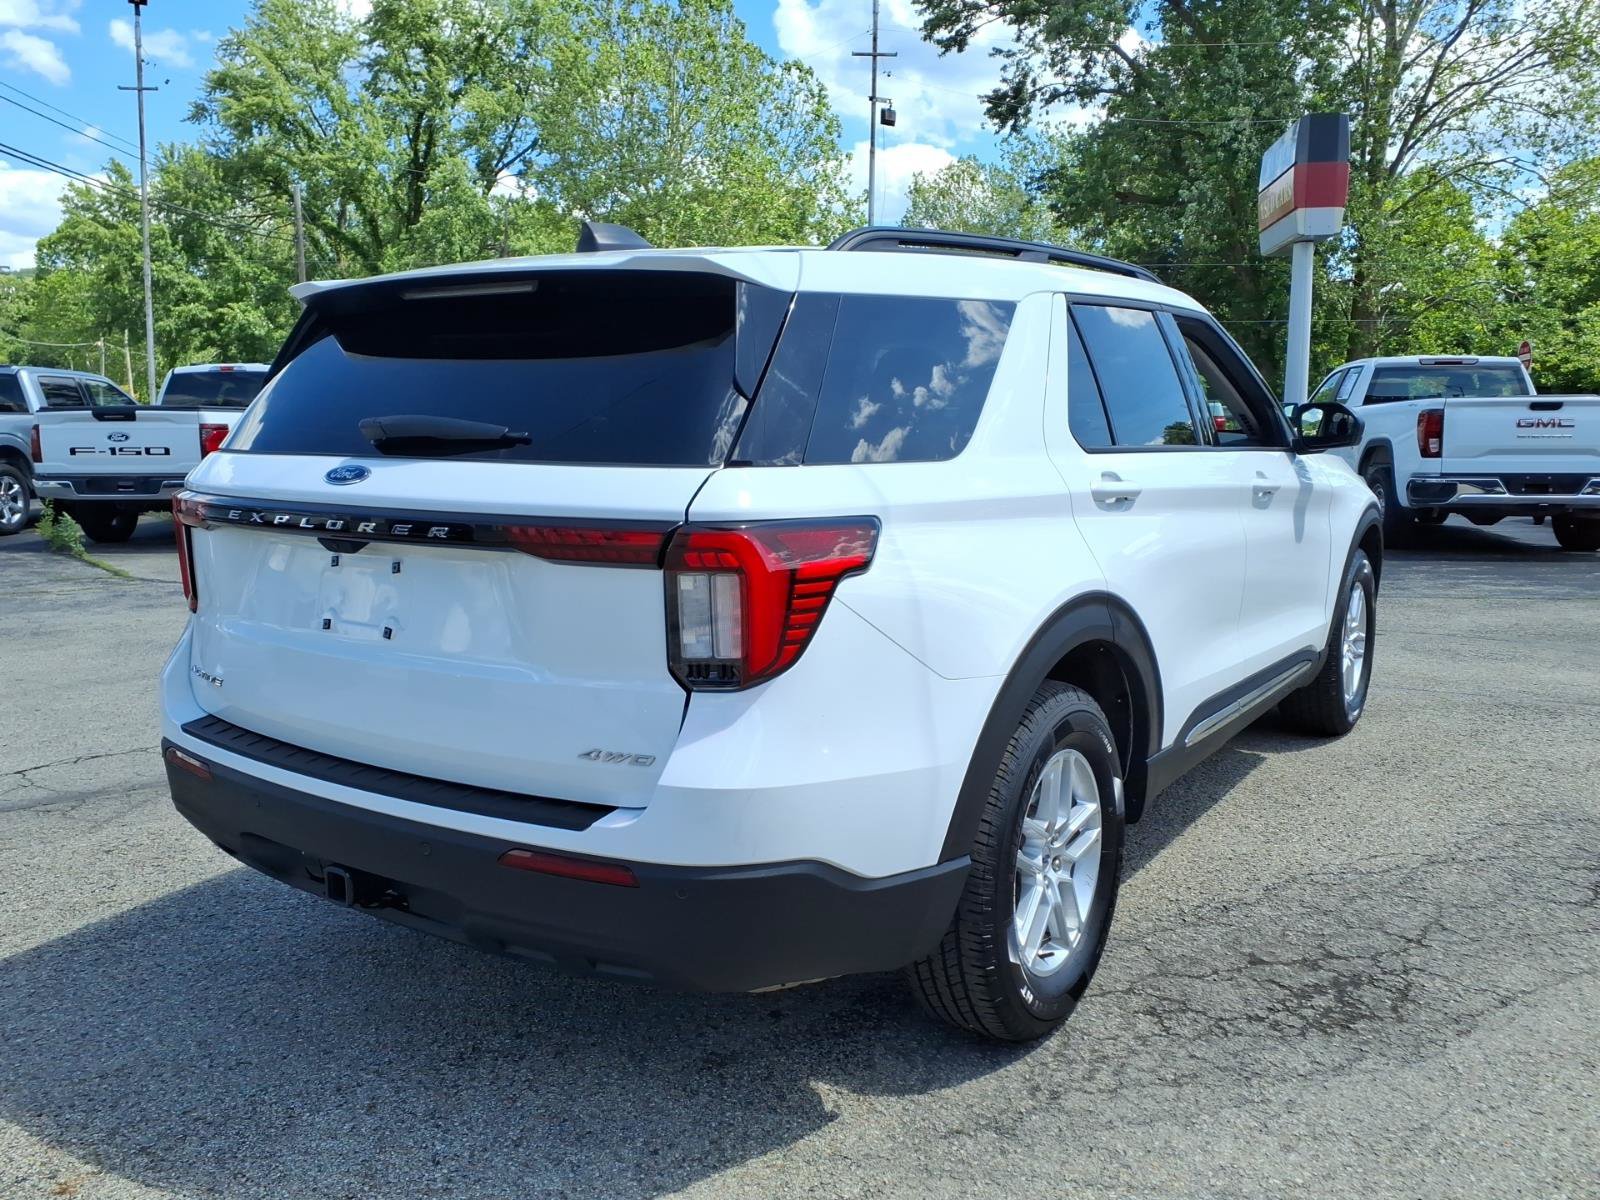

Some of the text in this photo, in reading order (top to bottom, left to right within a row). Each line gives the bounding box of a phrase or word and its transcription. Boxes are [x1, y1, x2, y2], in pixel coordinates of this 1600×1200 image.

[1516, 418, 1575, 429] GMC
[109, 432, 128, 442] Ford
[69, 446, 171, 456] F-150
[328, 466, 363, 480] Ford
[227, 509, 451, 539] EXPLORER
[577, 748, 657, 767] 4WD
